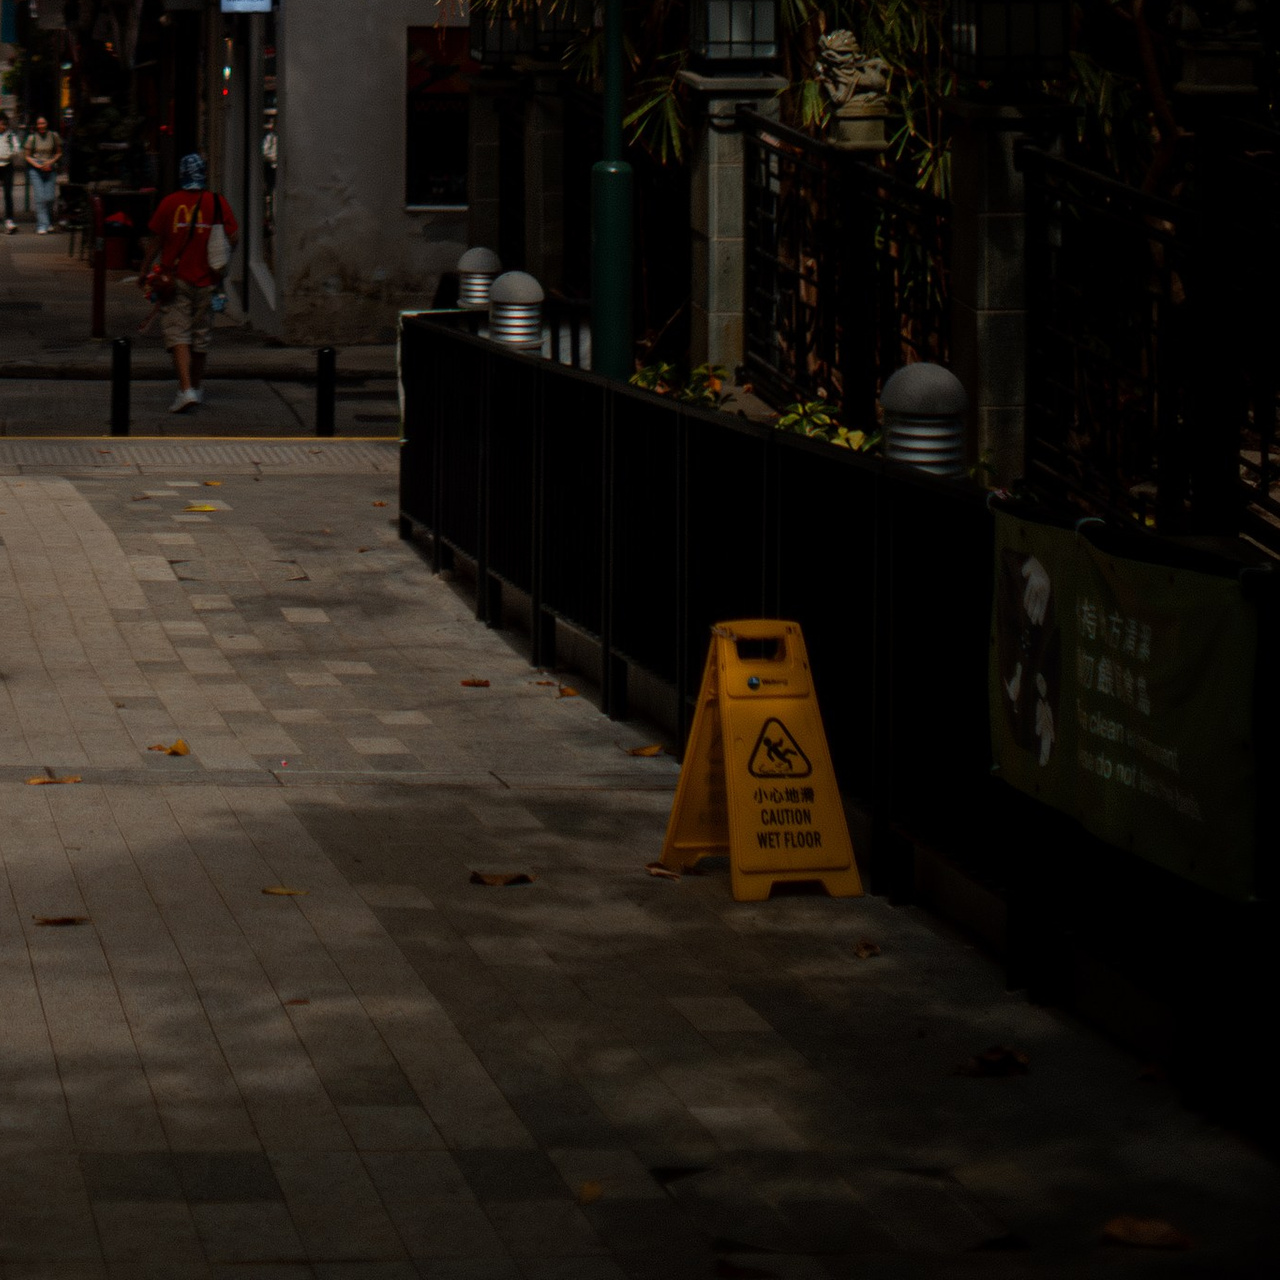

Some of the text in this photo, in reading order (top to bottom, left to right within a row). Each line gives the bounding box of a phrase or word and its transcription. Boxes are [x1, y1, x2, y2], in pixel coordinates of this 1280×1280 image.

[1096, 752, 1113, 779] do
[754, 786, 815, 804] 小心地滑
[761, 808, 812, 826] CAUTION
[757, 831, 822, 849] WET FLOOR
